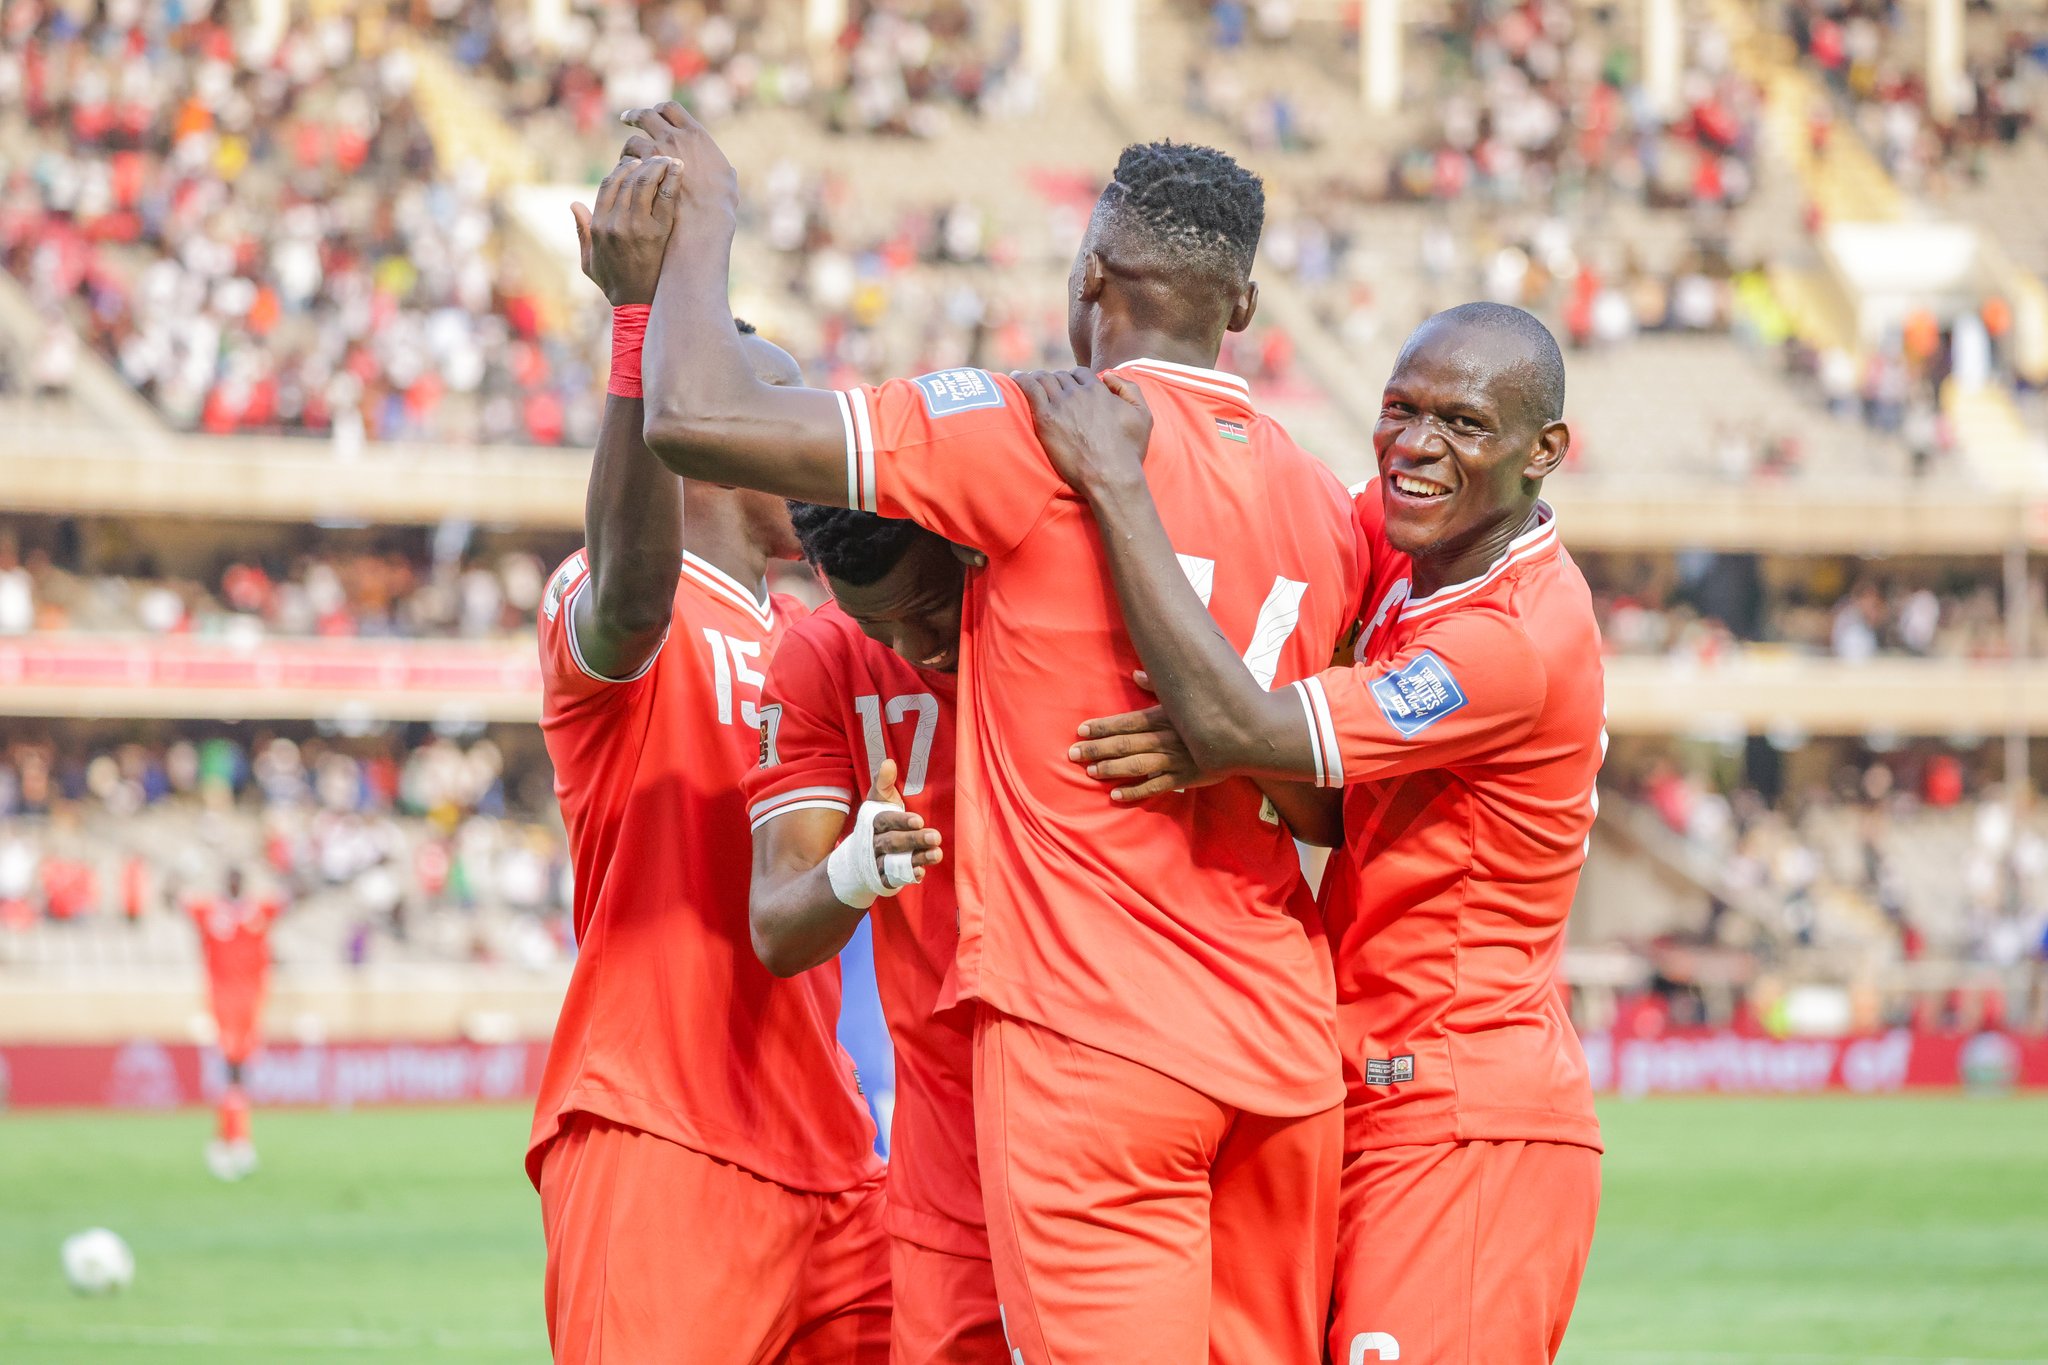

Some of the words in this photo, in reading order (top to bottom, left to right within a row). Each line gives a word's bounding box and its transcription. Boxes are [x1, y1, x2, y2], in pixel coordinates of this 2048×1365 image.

[702, 628, 765, 729] 15
[1396, 677, 1409, 694] the
[1405, 691, 1428, 718] World
[1408, 674, 1440, 711] UNITES
[1419, 666, 1449, 704] FOOTBALL
[1393, 696, 1408, 715] FIFA
[855, 692, 939, 796] 17
